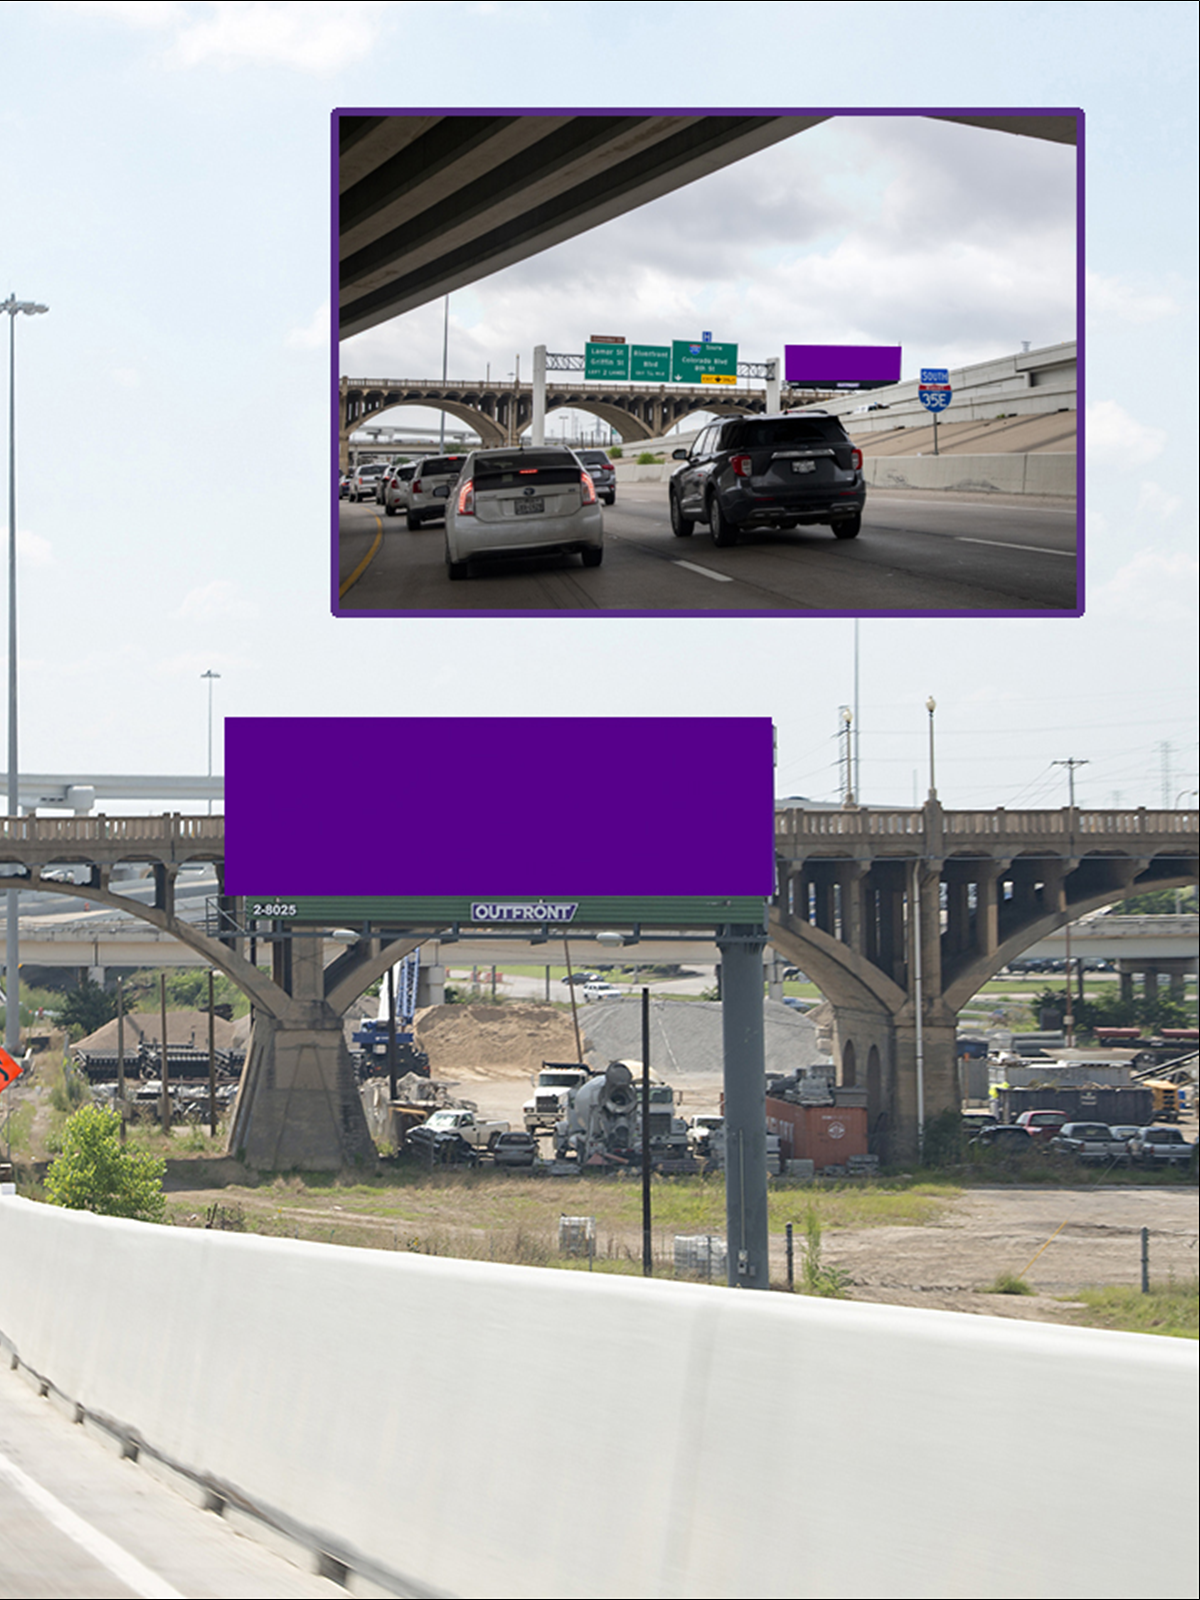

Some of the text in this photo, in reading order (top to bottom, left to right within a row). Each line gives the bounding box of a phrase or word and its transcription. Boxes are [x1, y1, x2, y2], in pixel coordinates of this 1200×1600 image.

[682, 356, 712, 364] Colorado
[922, 371, 948, 381] SOUTH
[922, 393, 947, 407] 35E
[253, 904, 297, 916] 2-8025
[475, 905, 571, 919] OUTFRONT
